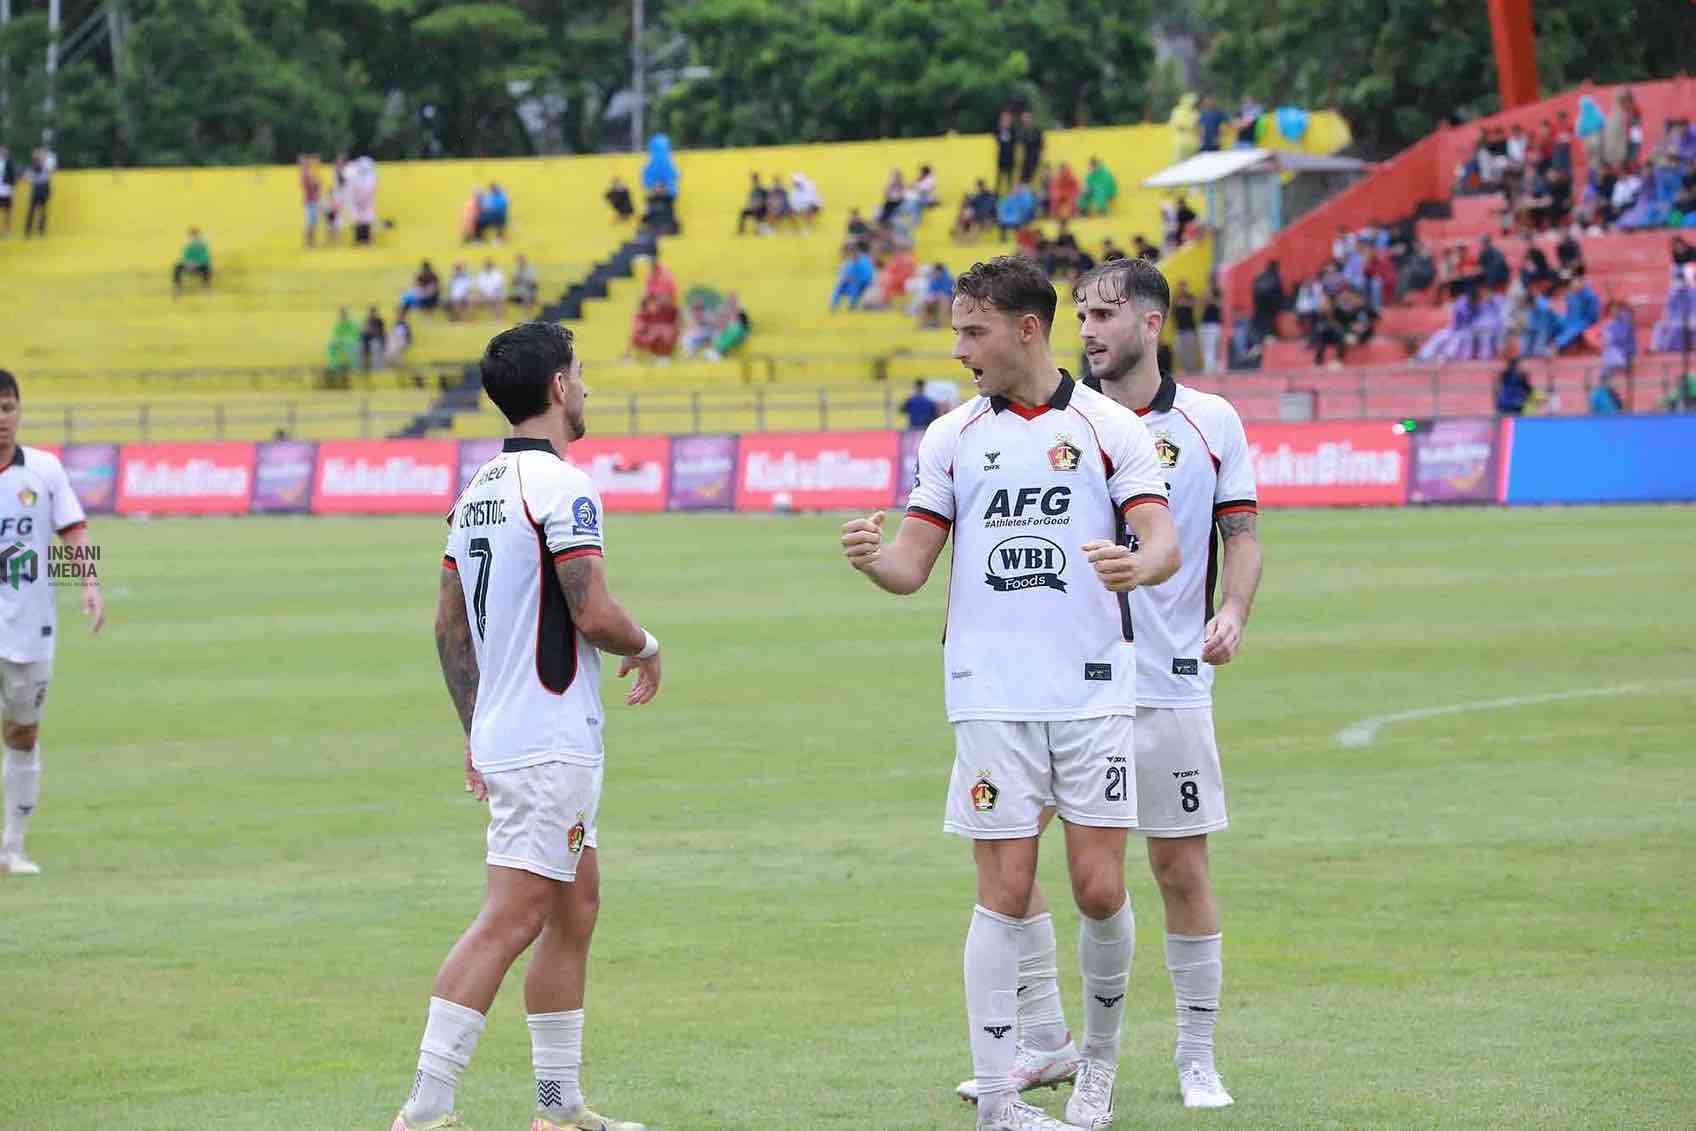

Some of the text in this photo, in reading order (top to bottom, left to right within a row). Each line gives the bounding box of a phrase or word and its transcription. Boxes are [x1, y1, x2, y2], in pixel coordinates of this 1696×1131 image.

[983, 486, 1072, 519] AFG
[984, 517, 1071, 529] #AthletesForGood
[999, 547, 1055, 570] WBI
[469, 537, 493, 643] 7
[1005, 574, 1047, 590] Foods
[1105, 766, 1127, 802] 21
[1180, 781, 1200, 813] 8
